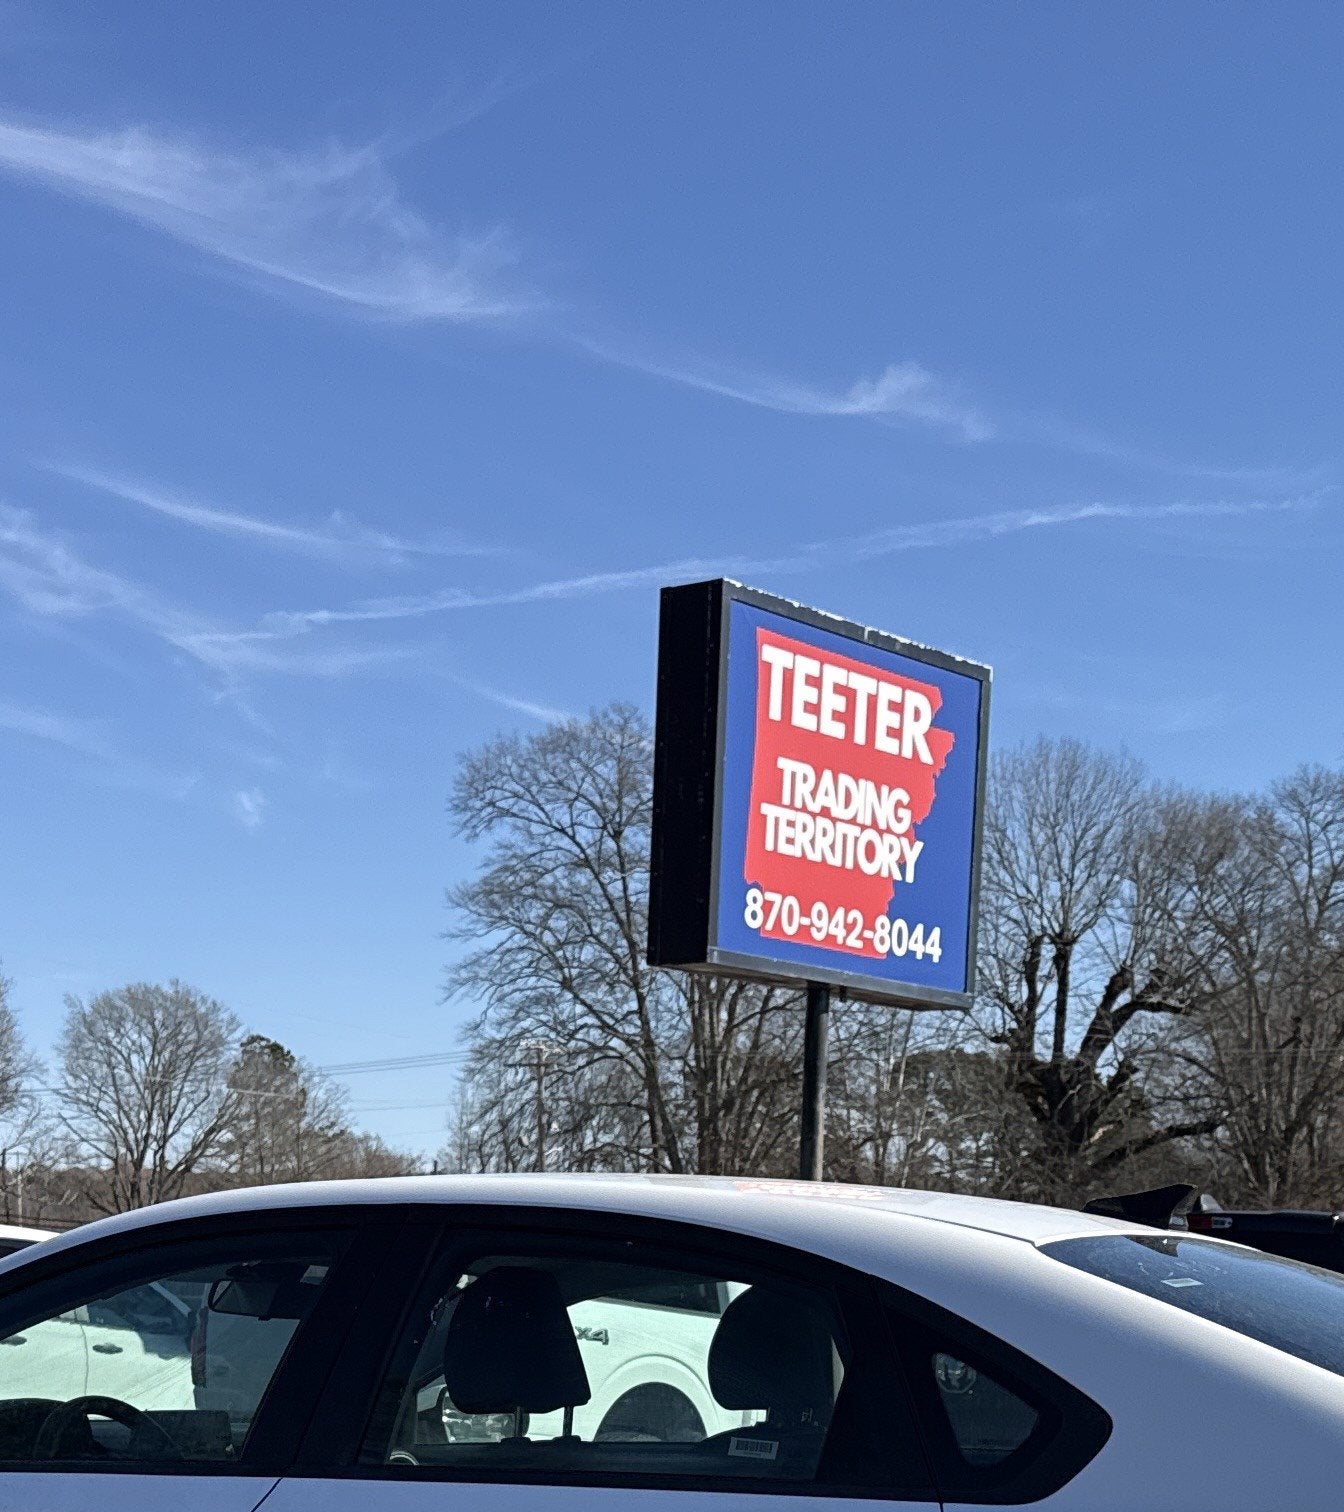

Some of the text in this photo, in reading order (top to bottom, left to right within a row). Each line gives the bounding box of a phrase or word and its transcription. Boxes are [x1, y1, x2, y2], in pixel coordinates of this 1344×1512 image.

[761, 644, 934, 766] TEETER
[777, 757, 911, 834] TRADING
[760, 803, 923, 883] TERRITORY
[744, 888, 942, 963] 870-942-8044
